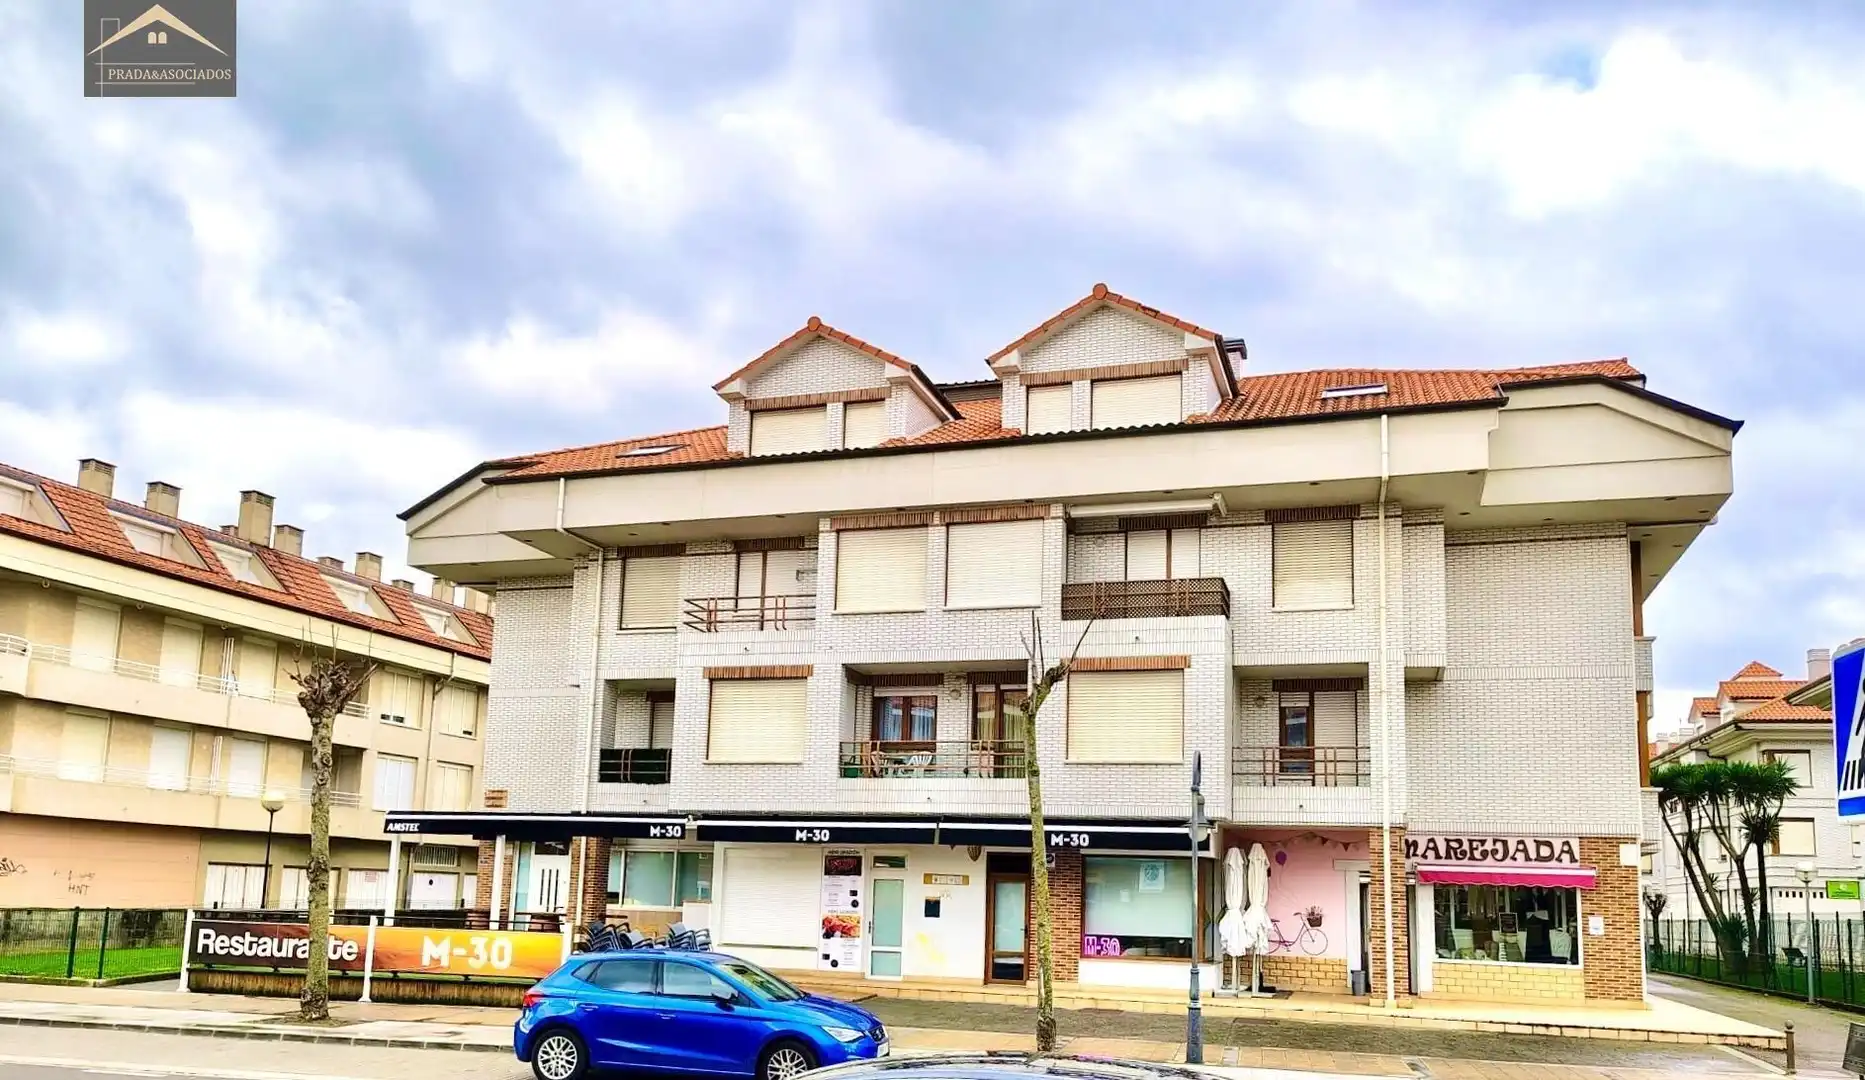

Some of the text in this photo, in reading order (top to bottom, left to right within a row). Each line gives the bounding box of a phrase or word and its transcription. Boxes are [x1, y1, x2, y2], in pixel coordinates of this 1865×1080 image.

[386, 822, 420, 832] AMSTEL
[650, 825, 682, 838] M-30
[795, 829, 830, 842] M-30
[1050, 833, 1090, 847] M-30
[197, 928, 358, 961] Restaurate
[1085, 936, 1120, 956] M-30
[421, 935, 513, 970] M-30
